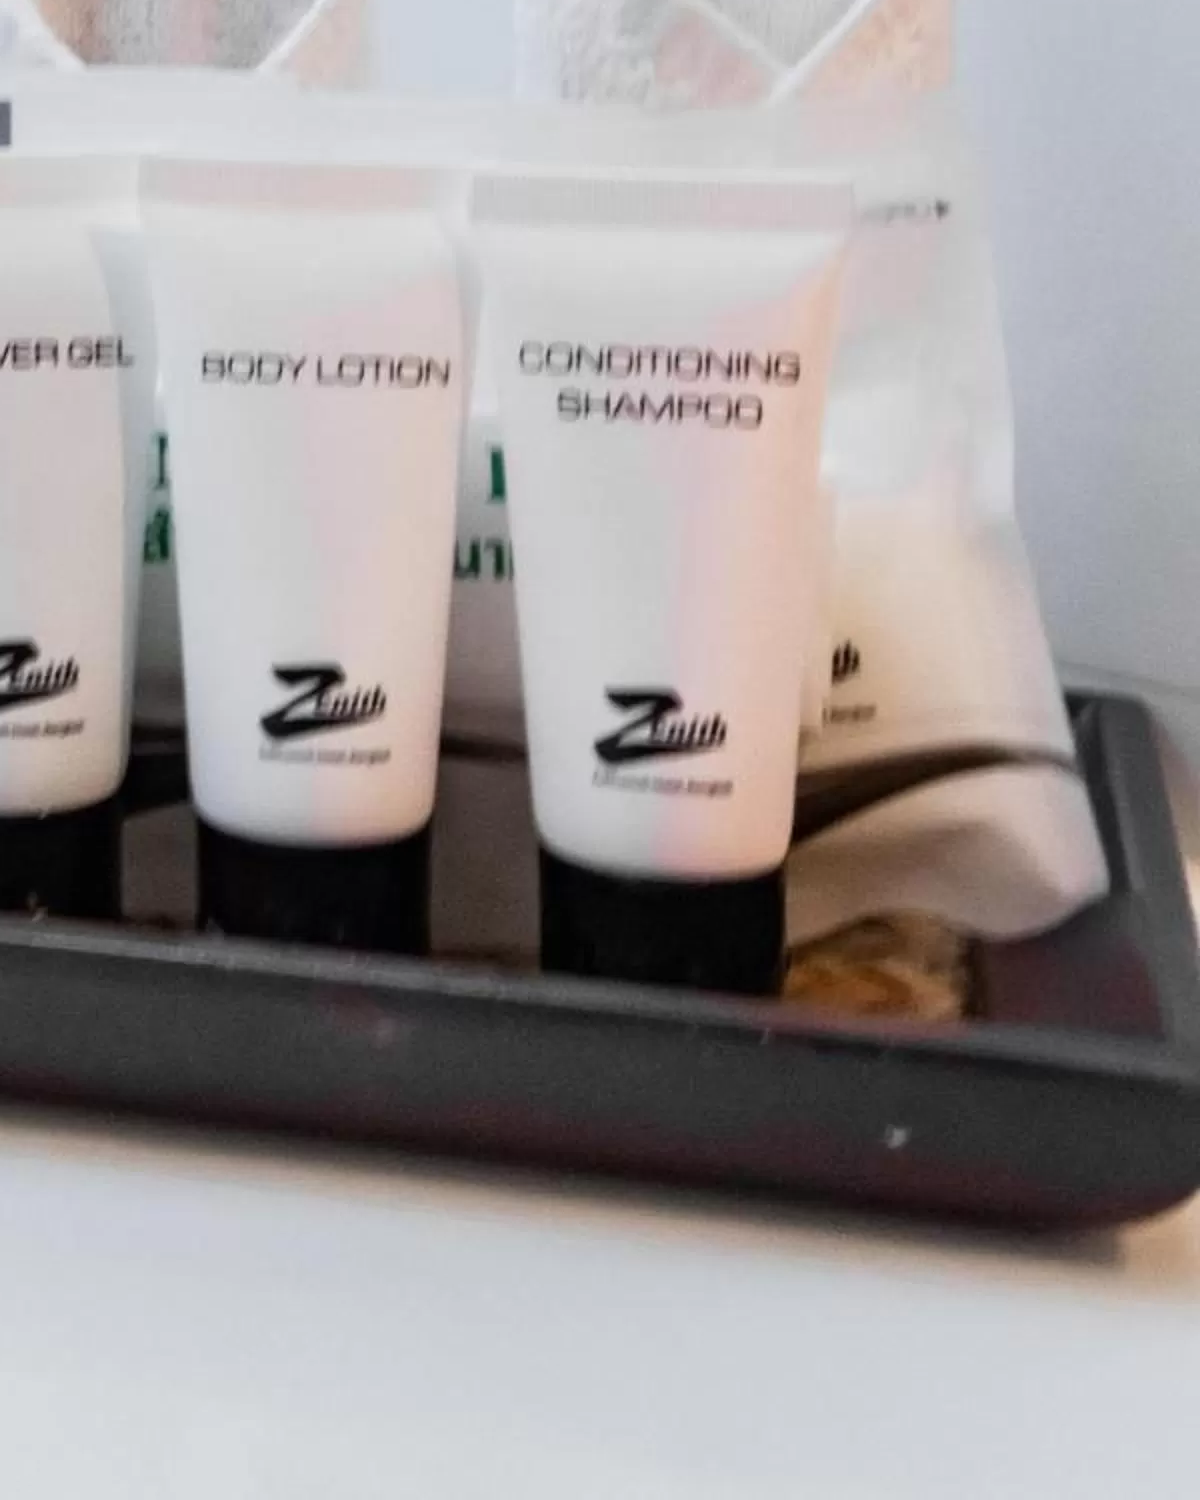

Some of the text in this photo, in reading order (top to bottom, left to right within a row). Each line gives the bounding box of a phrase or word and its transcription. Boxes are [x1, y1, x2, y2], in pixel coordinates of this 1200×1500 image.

[67, 335, 133, 368] GEL
[202, 350, 451, 388] BODY LOTION
[518, 340, 801, 386] CONDITIONING
[557, 389, 763, 430] SHAMPOO
